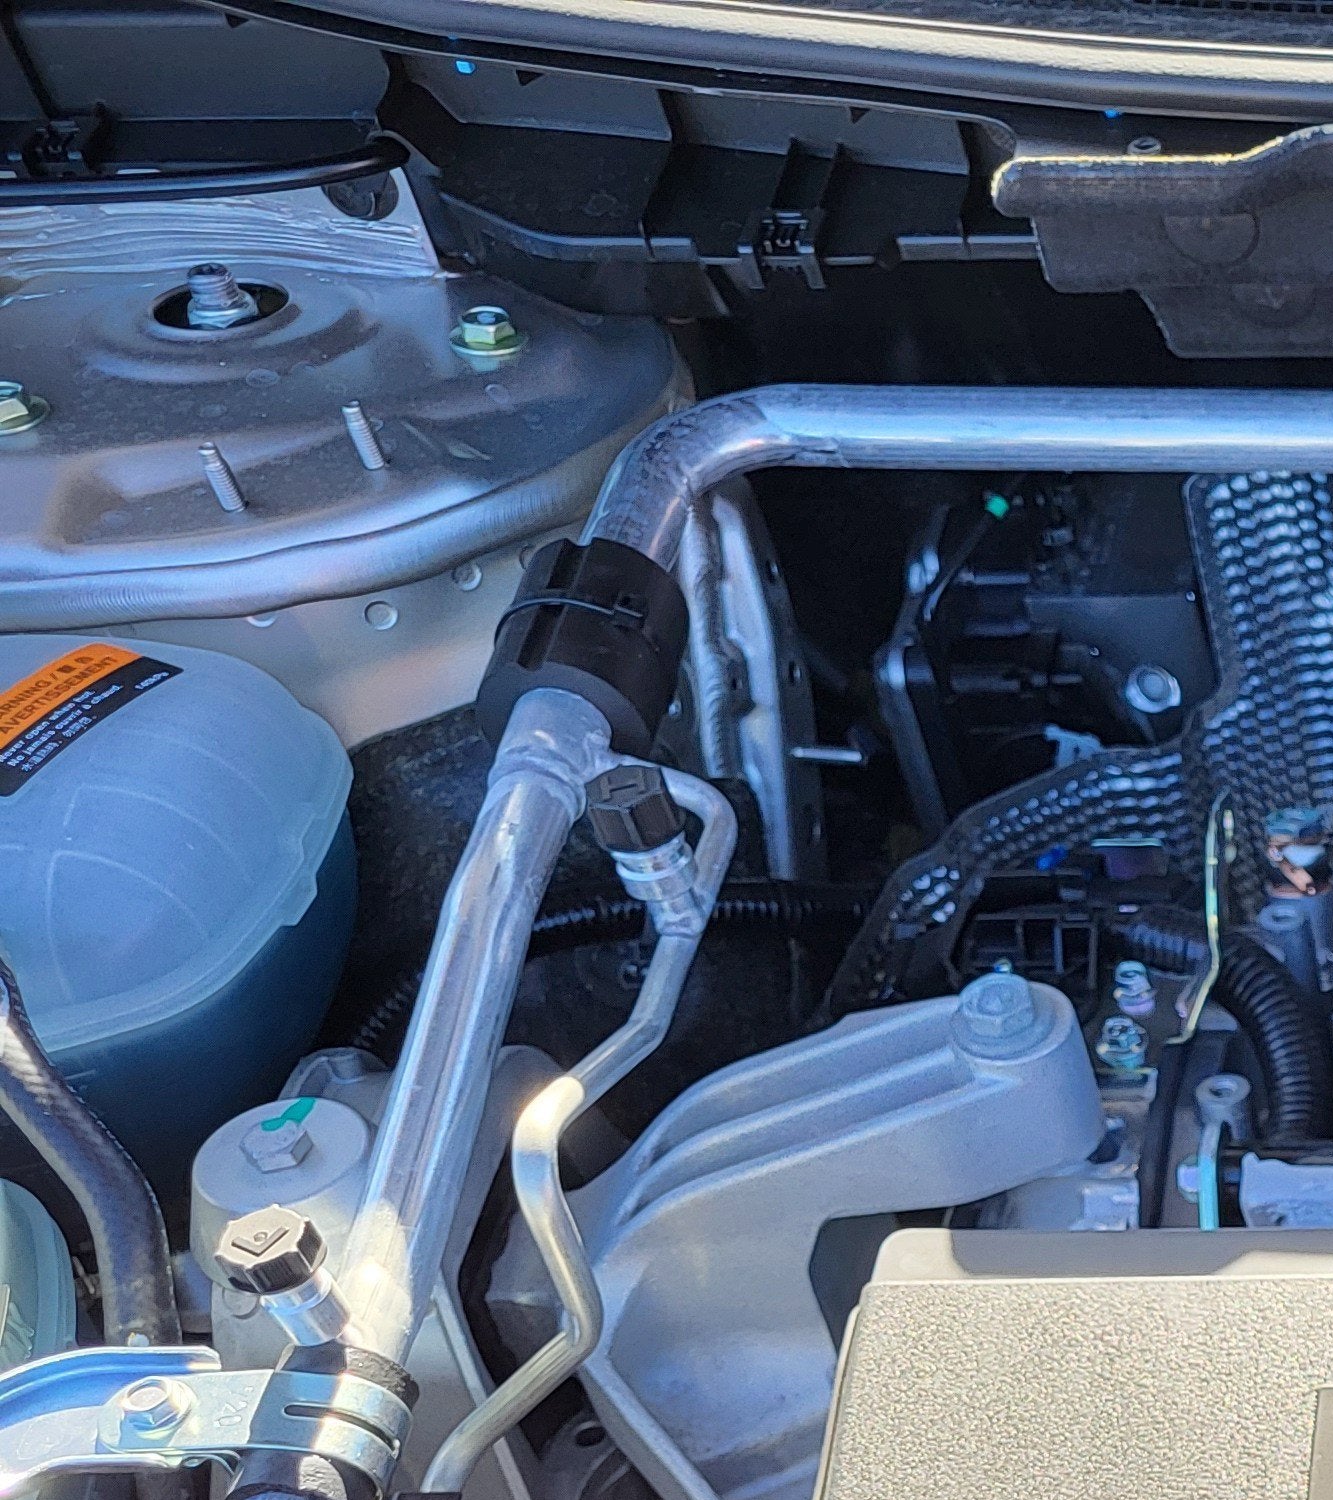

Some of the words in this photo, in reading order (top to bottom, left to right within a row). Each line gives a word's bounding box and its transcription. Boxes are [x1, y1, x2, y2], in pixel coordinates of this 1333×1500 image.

[0, 679, 52, 719] ARNING
[1, 656, 118, 735] AVERTISSEMENT
[25, 720, 50, 740] open
